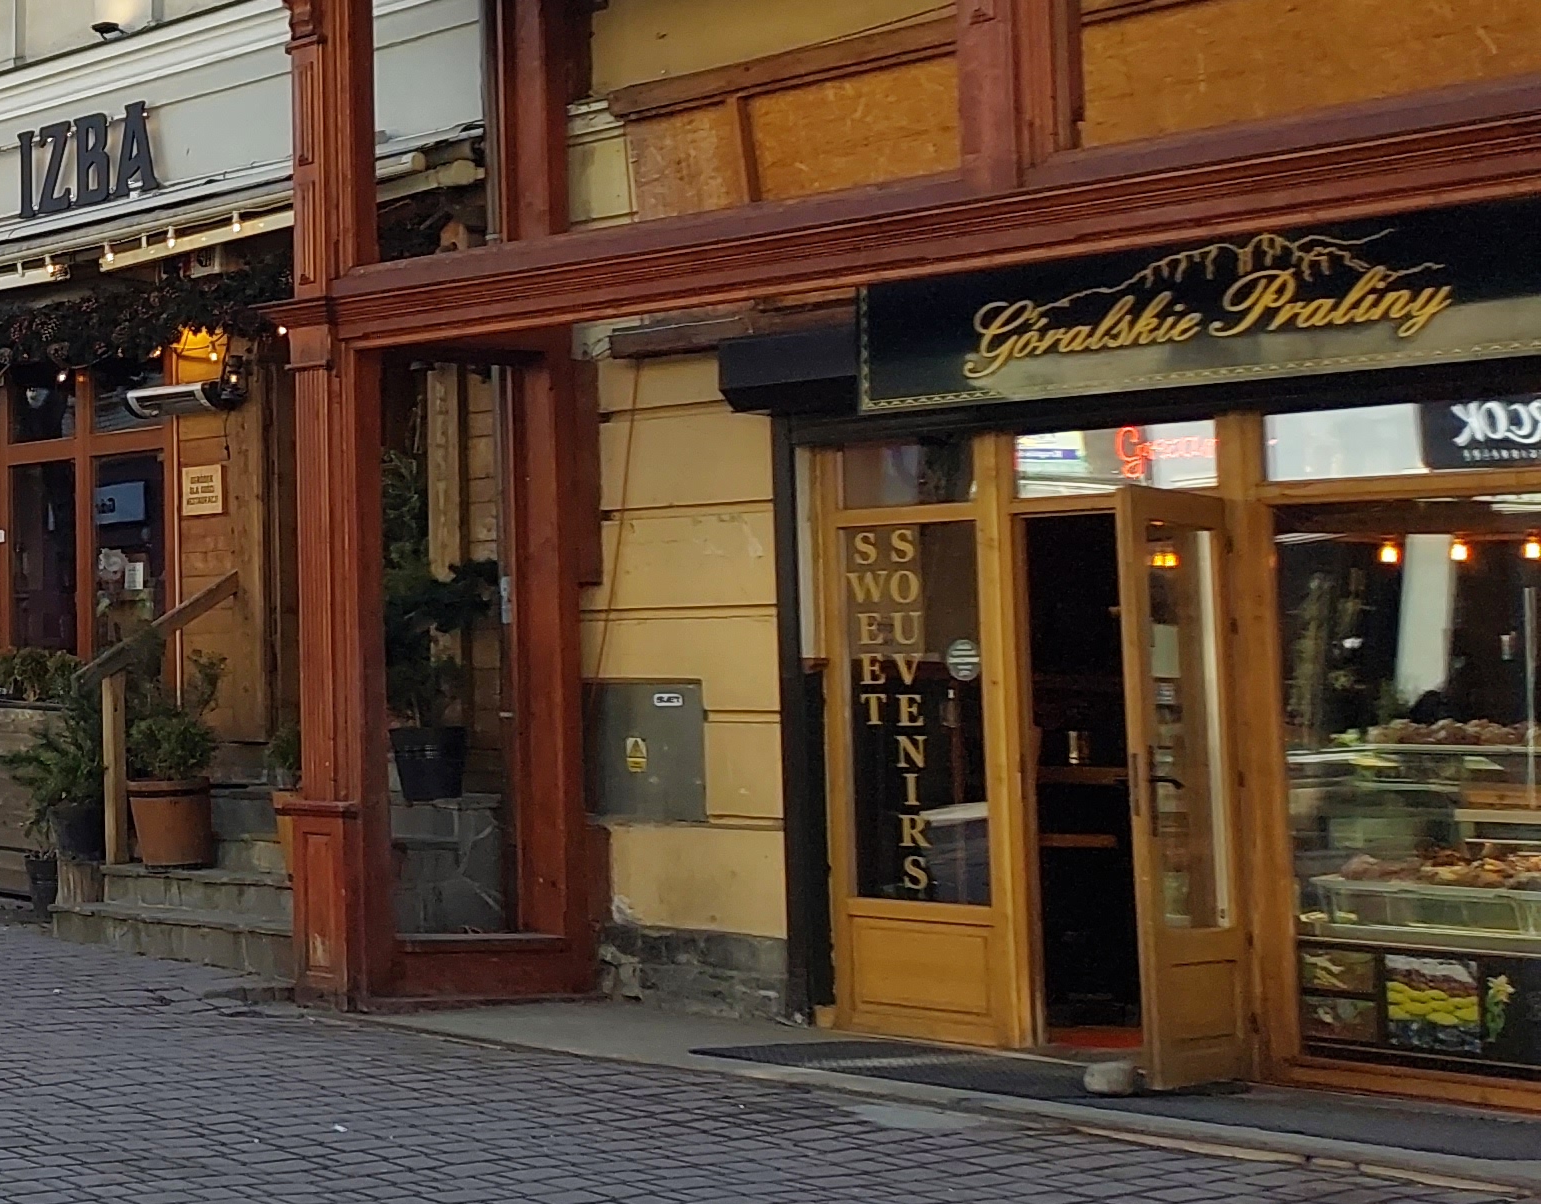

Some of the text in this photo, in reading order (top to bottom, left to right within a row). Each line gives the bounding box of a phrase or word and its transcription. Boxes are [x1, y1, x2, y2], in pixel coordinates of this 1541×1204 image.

[18, 100, 160, 219] IZBA
[963, 265, 1453, 378] Góralskie Praliny
[847, 533, 888, 726] SWEET
[890, 528, 931, 890] SOUVENIRS
